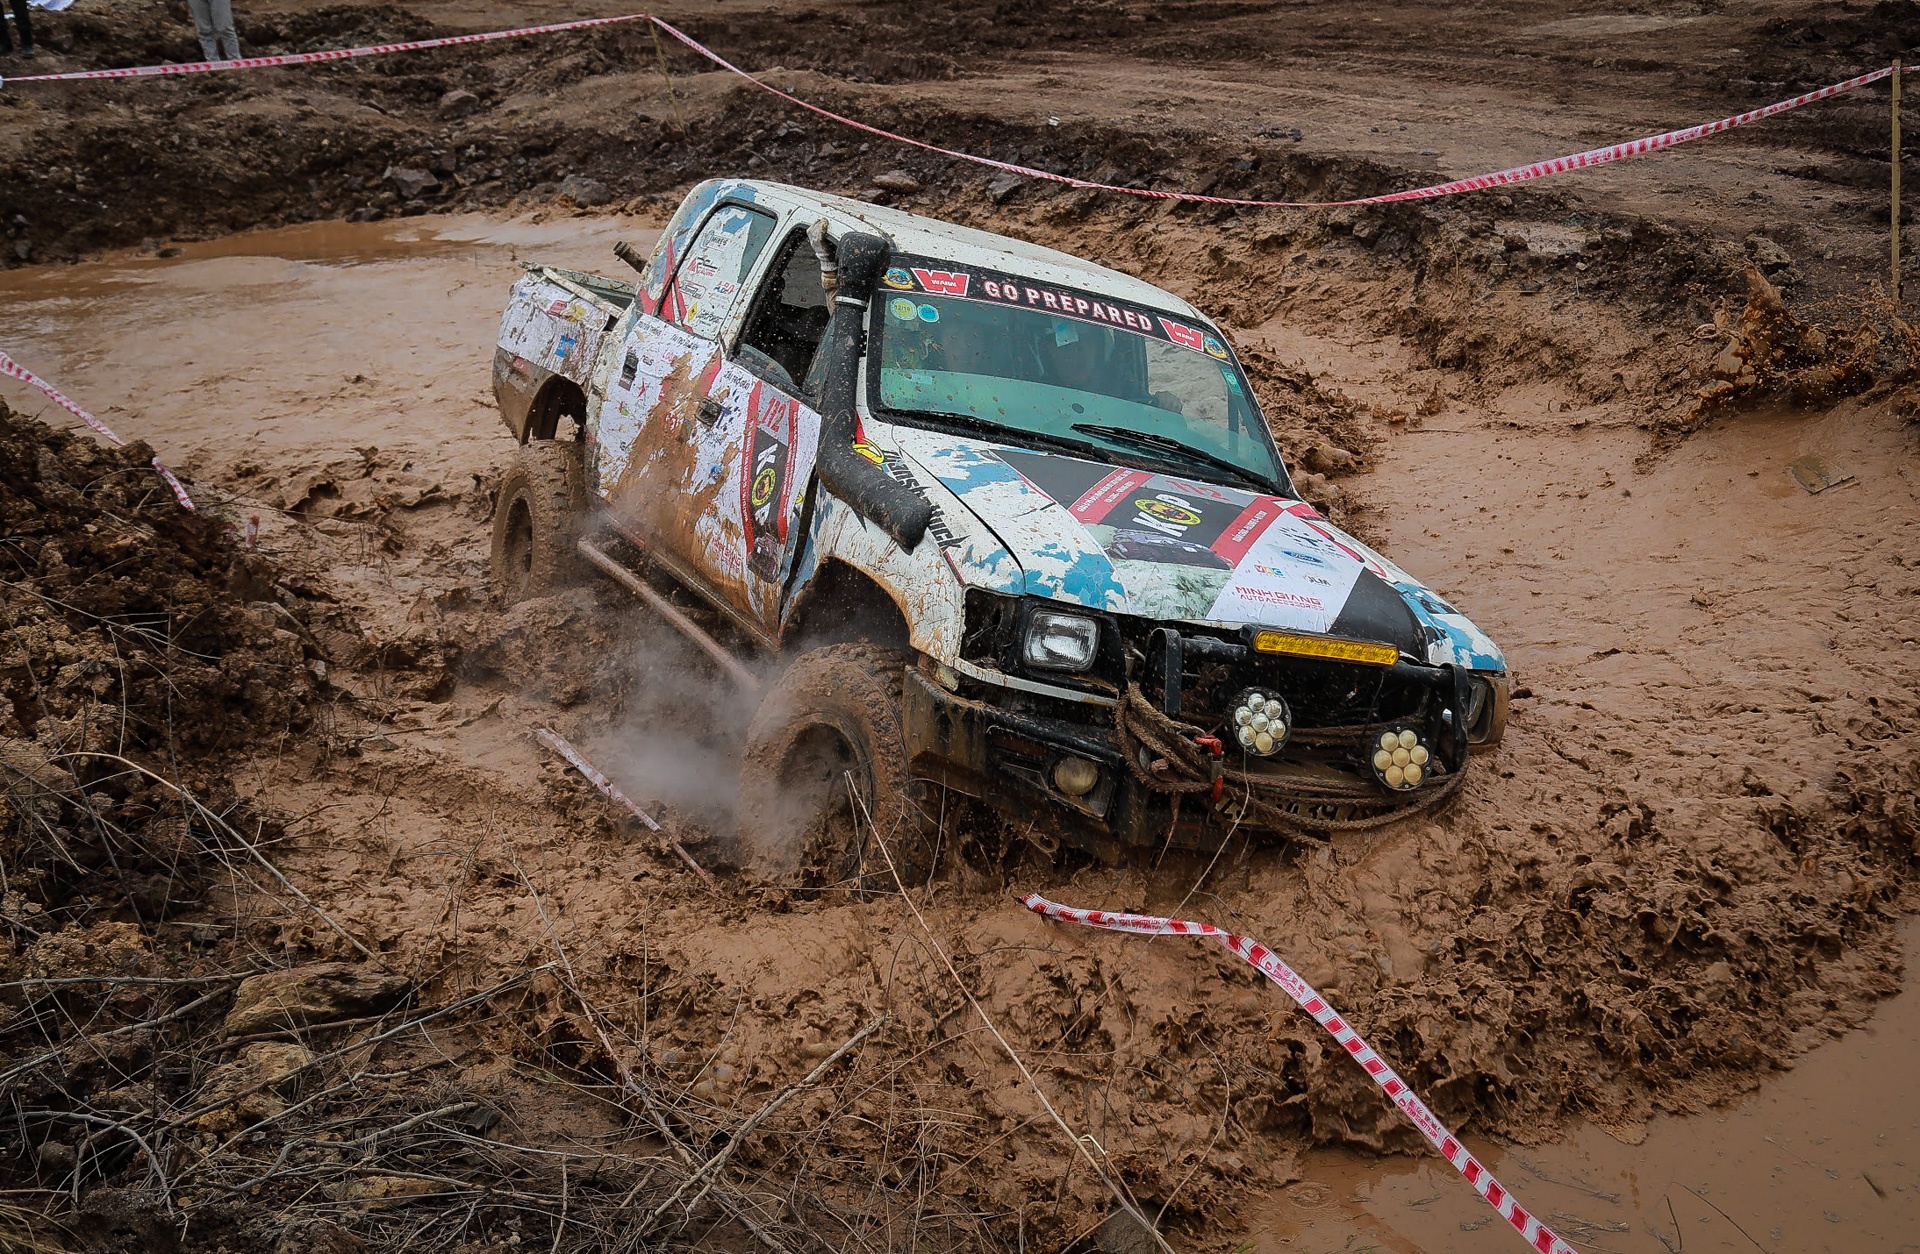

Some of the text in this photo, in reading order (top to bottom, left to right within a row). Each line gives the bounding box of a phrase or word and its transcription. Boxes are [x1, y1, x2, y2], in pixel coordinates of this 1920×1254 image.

[984, 280, 1152, 331] GO PREPARED
[1235, 586, 1322, 605] MINH GIANG
